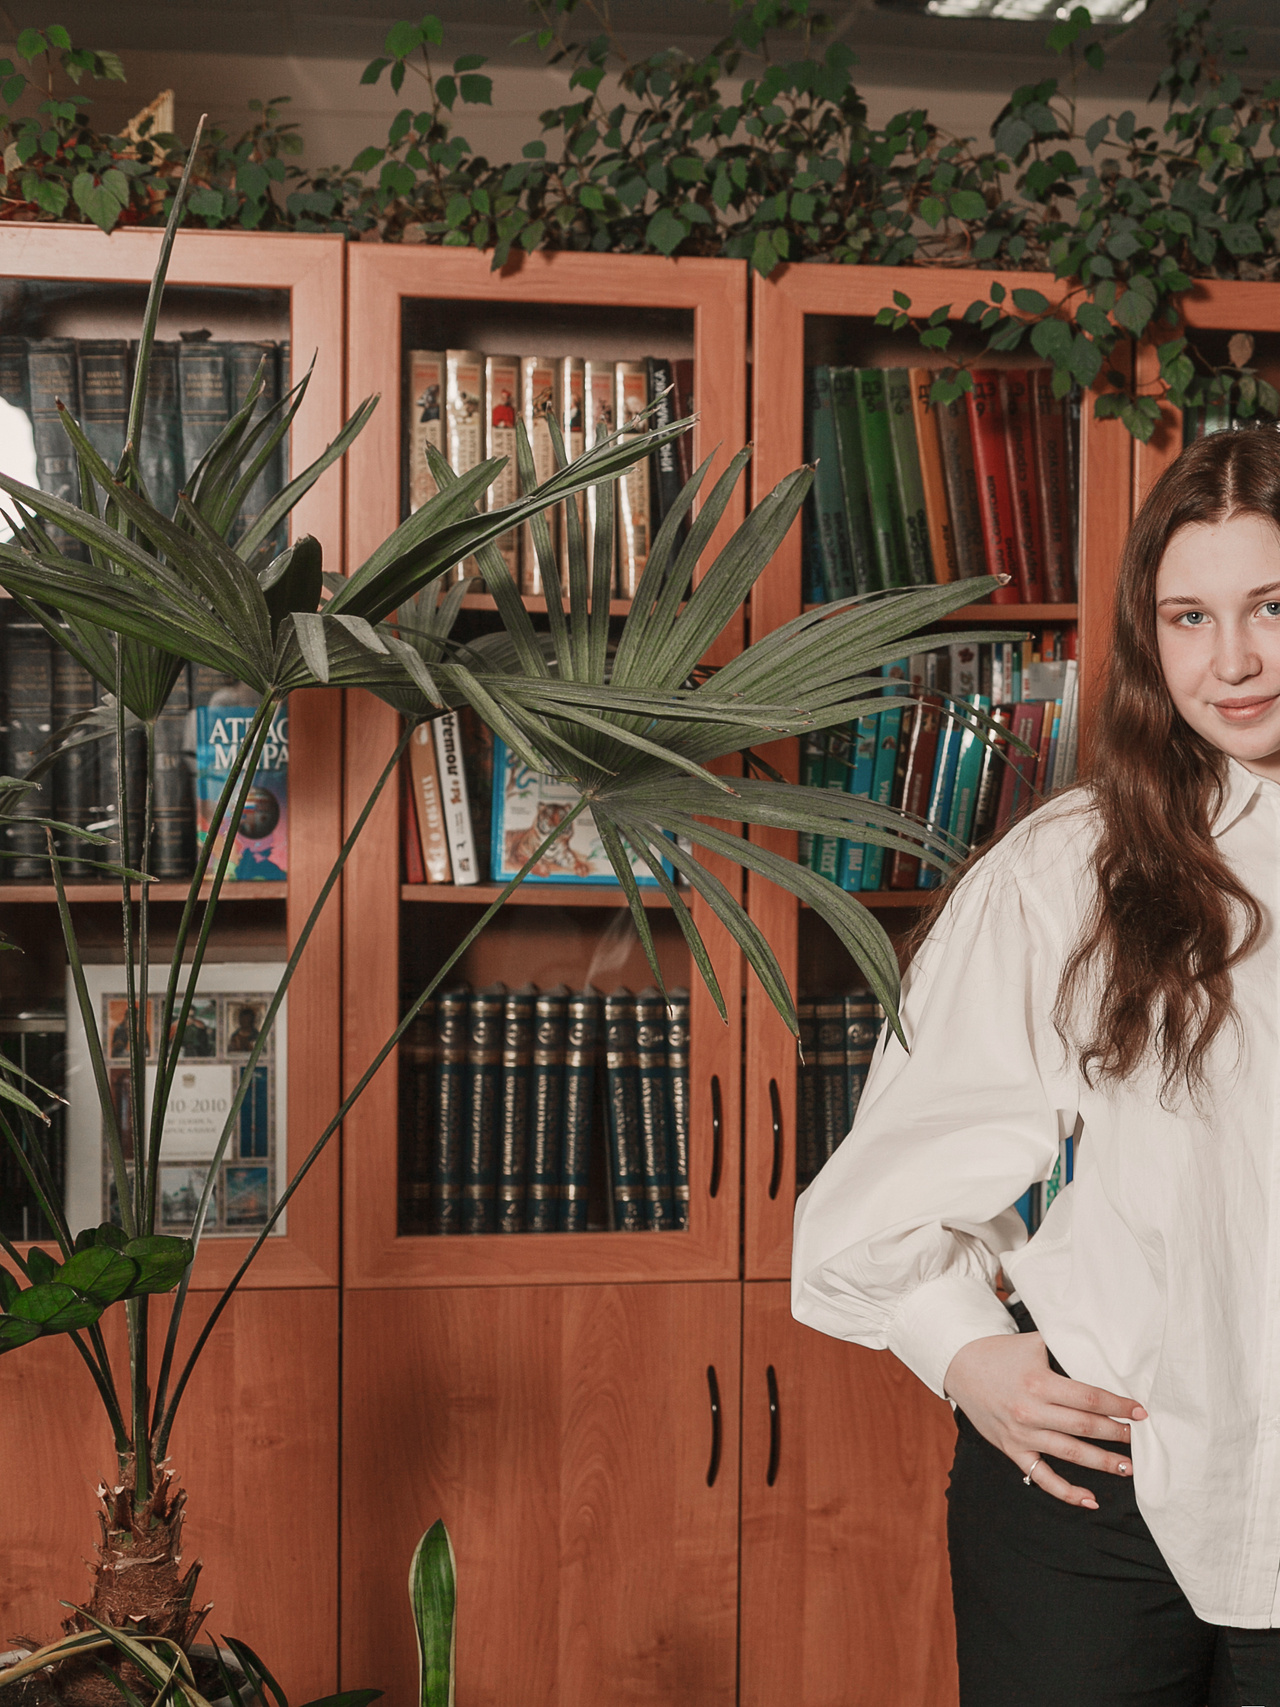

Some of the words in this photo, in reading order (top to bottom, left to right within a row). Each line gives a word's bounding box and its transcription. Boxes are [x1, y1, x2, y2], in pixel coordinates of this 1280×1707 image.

[1014, 426, 1026, 481] страны
[1047, 440, 1061, 529] литература
[987, 475, 1002, 545] Советская
[1020, 490, 1037, 585] Зарубежные
[214, 743, 288, 770] МРА
[440, 712, 459, 776] лошад
[191, 1098, 228, 1114] 2010
